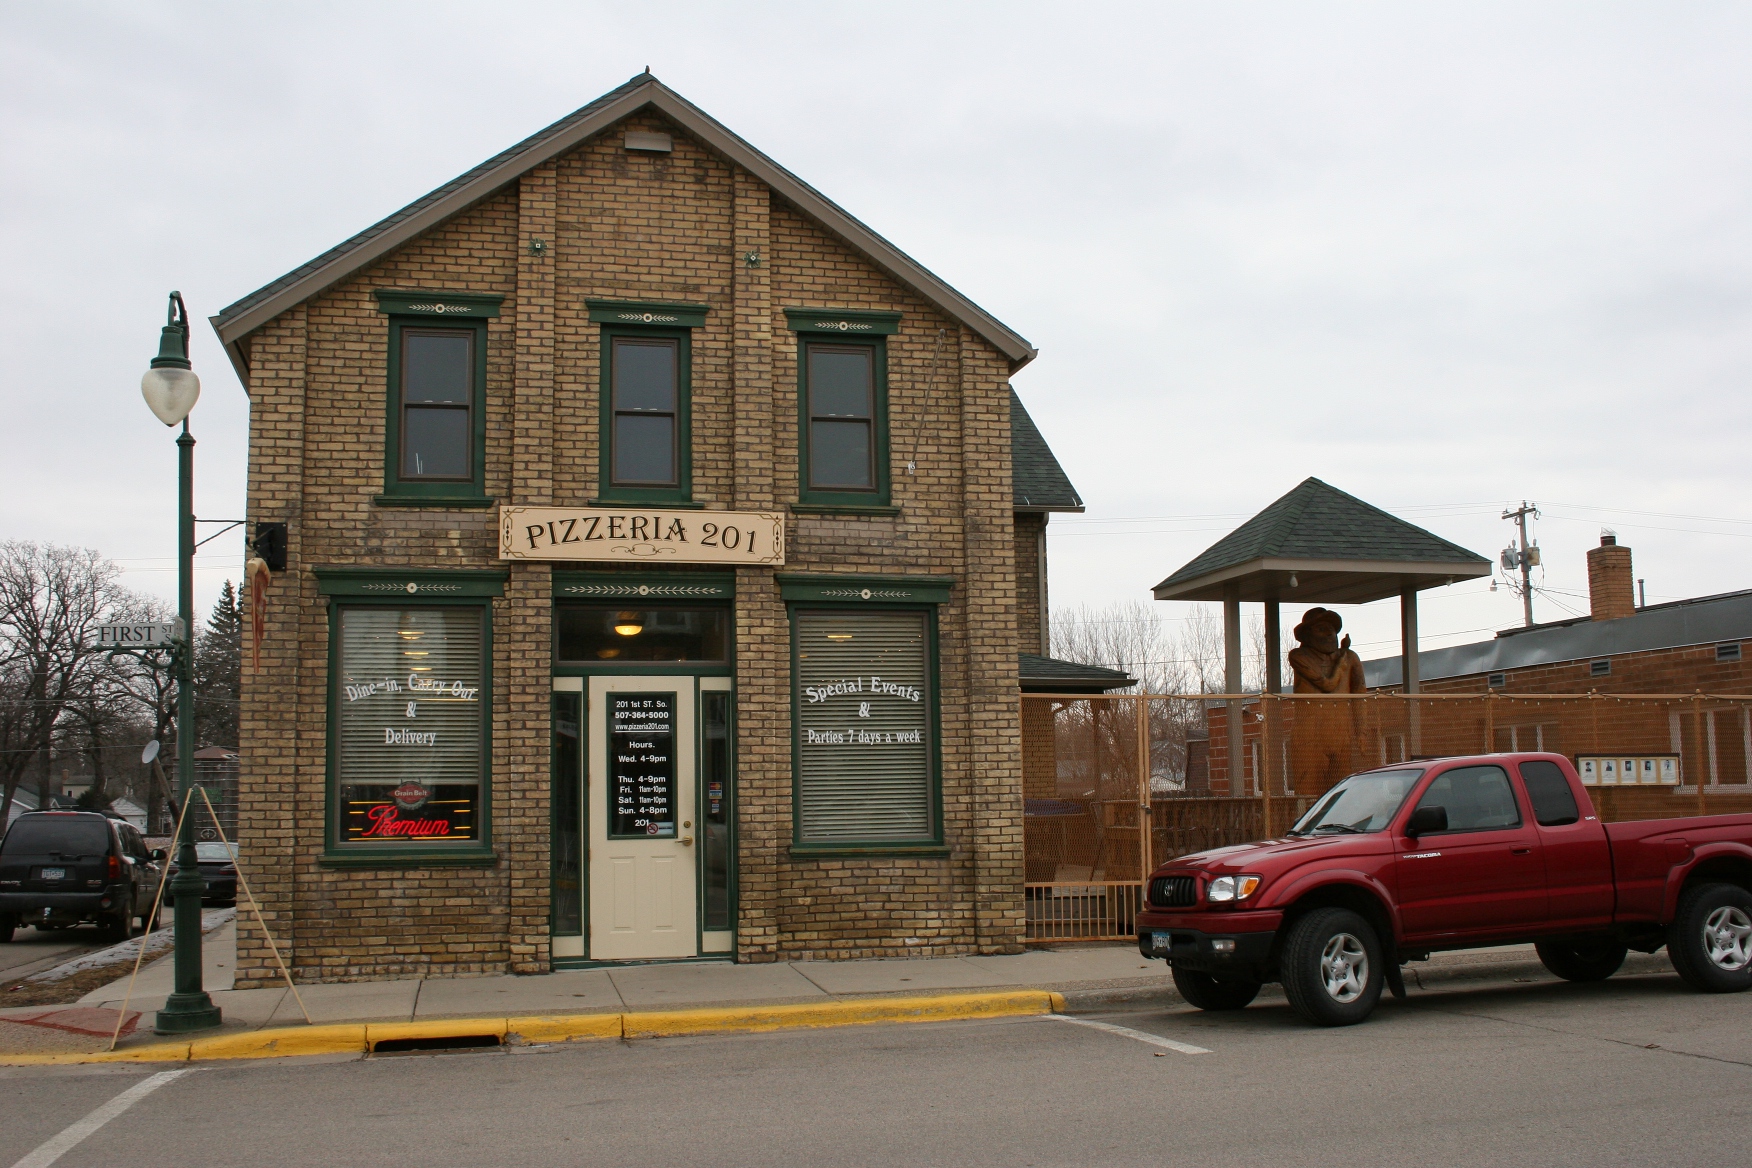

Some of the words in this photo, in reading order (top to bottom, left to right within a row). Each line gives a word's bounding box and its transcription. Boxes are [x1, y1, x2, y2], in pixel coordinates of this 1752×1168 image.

[526, 515, 689, 550] PIZZERIA
[700, 522, 757, 554] 201
[100, 626, 155, 642] FIRST
[162, 625, 173, 633] ST
[345, 677, 402, 702] Dine-in,
[408, 673, 446, 695] Carry
[451, 680, 475, 700] Out
[806, 677, 862, 703] Special
[871, 676, 920, 702] Events
[406, 701, 416, 717] &
[859, 702, 870, 717] &
[615, 723, 669, 731] www.pizzeria201.com
[385, 728, 436, 746] Delivery
[808, 730, 844, 743] Parties
[848, 729, 854, 742] 7
[858, 730, 881, 745] days
[886, 734, 891, 742] a
[896, 729, 920, 743] week
[618, 755, 637, 763] Wed.
[640, 755, 666, 764] 4-9pm
[638, 776, 666, 784] 4-9pm
[639, 786, 666, 794] 11am-10pm
[639, 796, 667, 804] 11am-10pm
[639, 807, 667, 815] 4-8pm
[361, 805, 450, 836] Premium
[635, 819, 649, 827] 201
